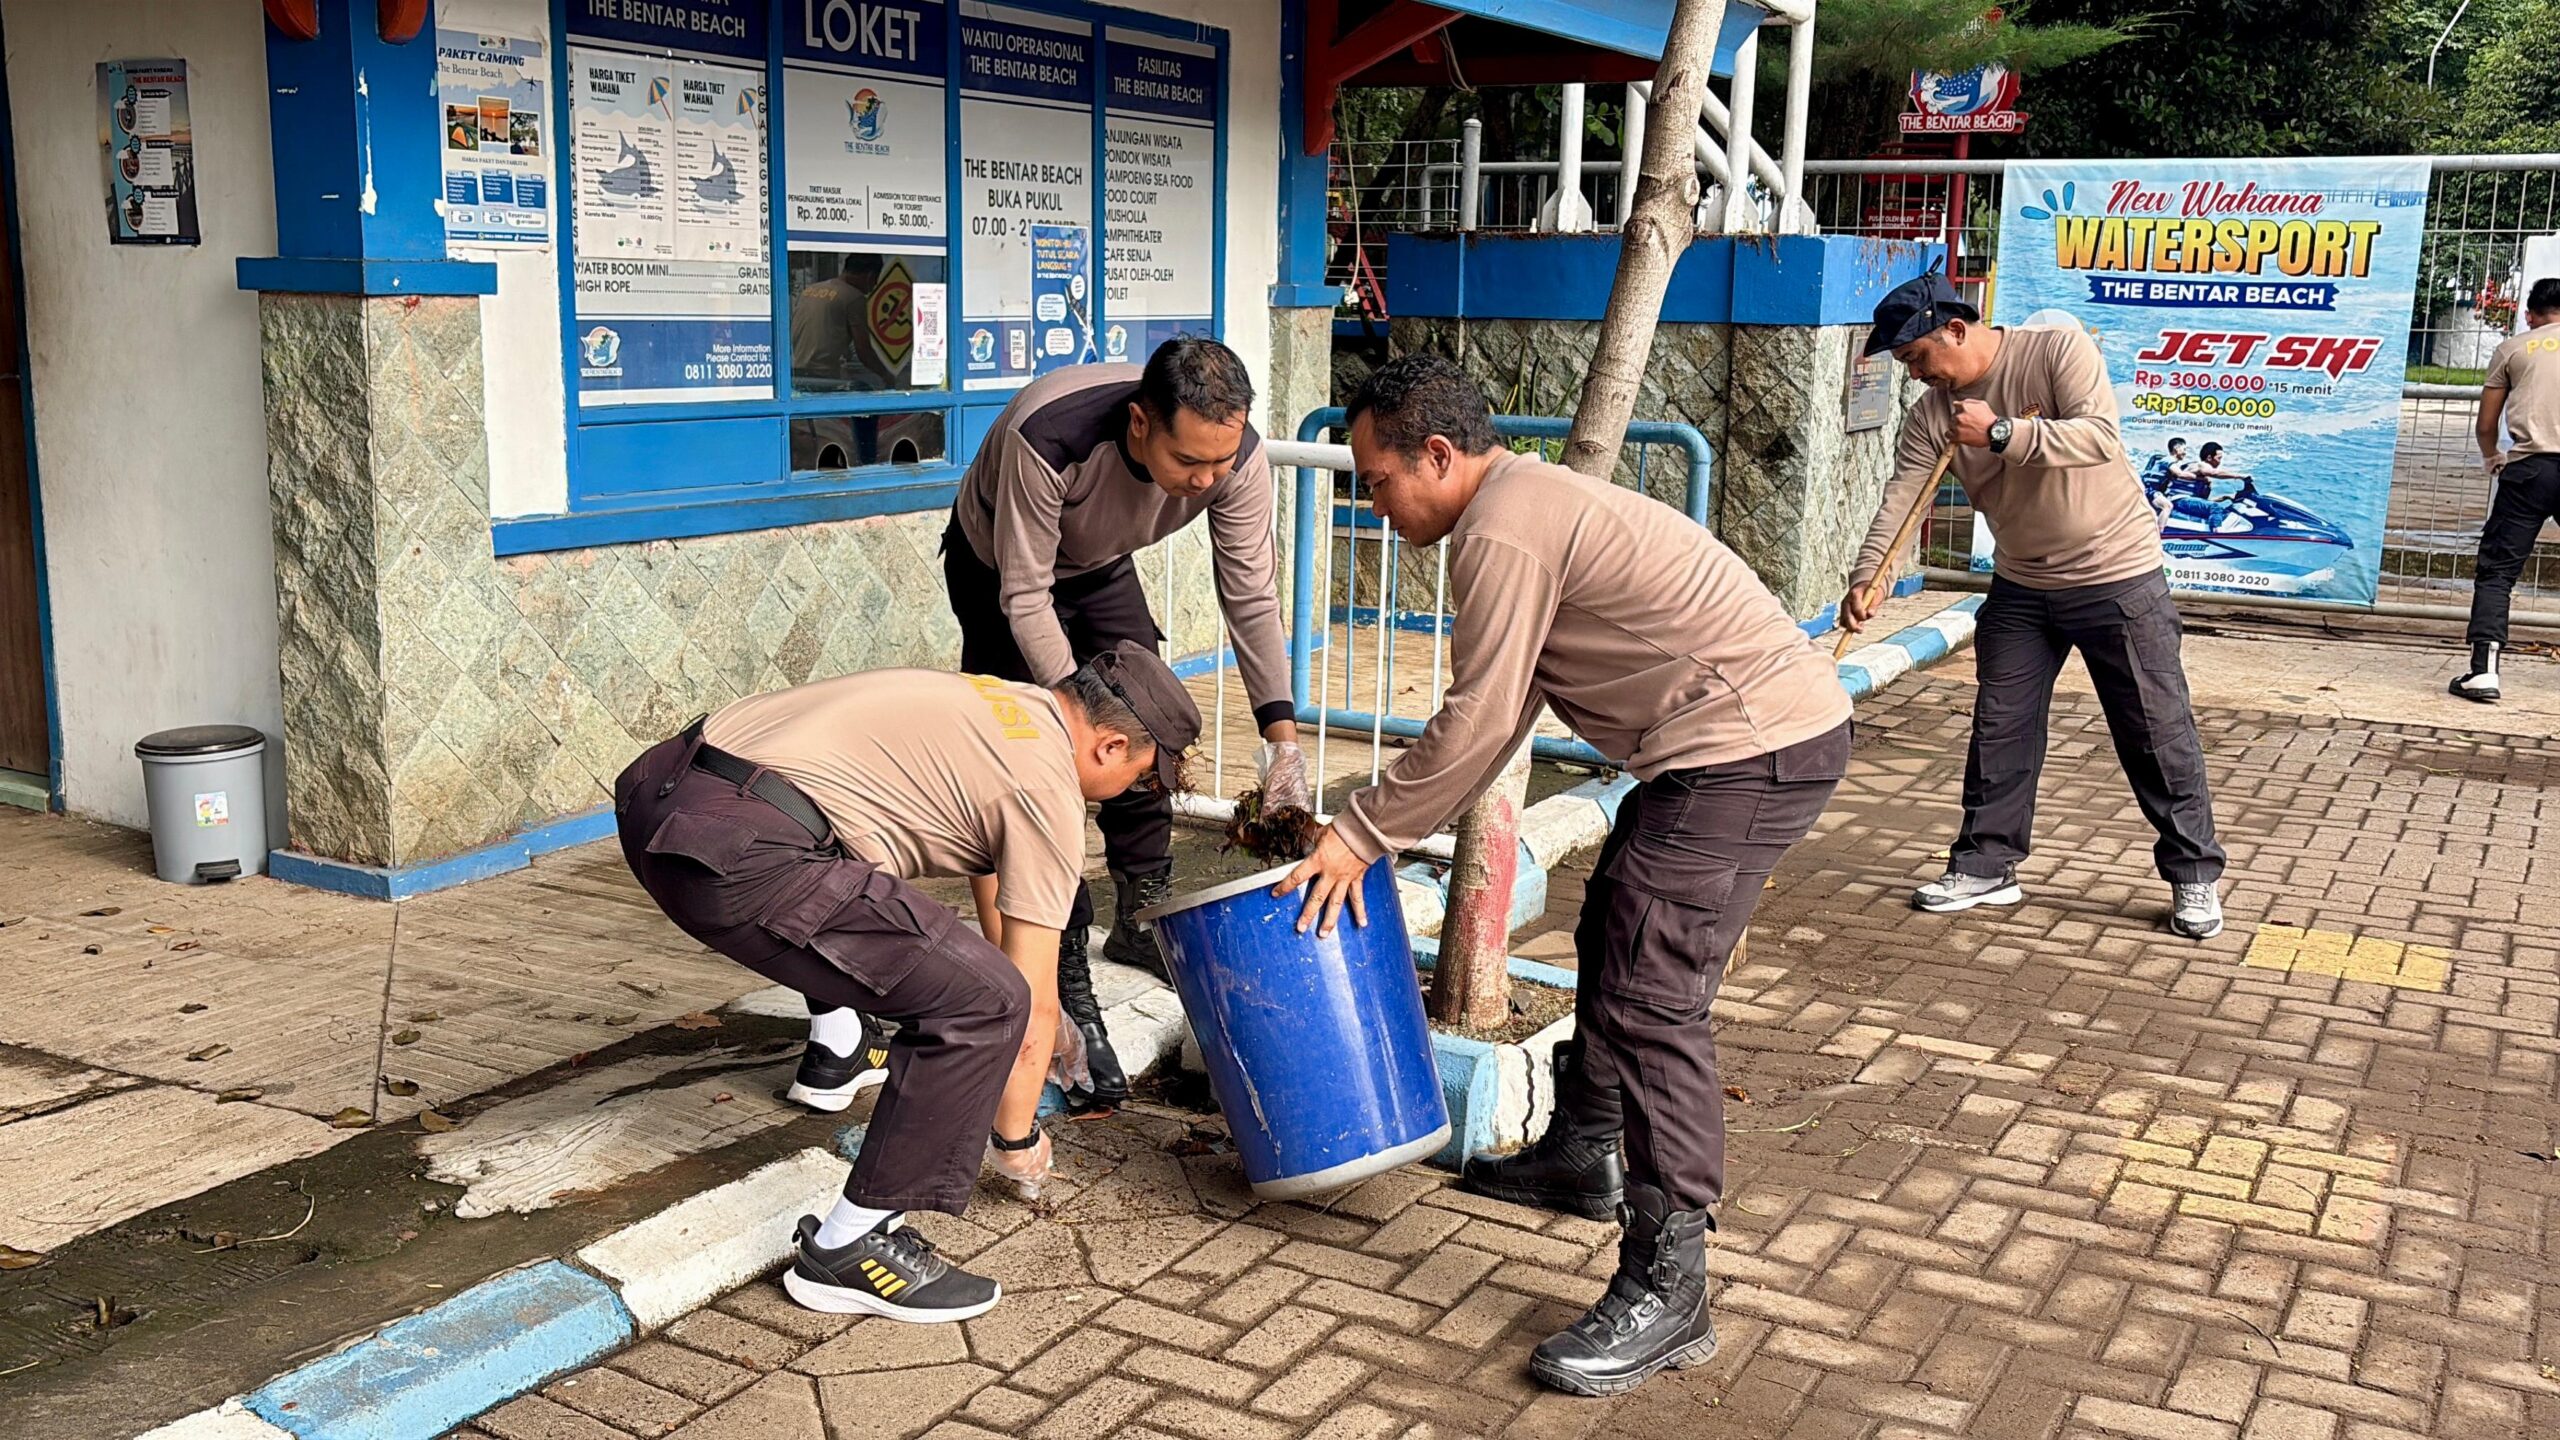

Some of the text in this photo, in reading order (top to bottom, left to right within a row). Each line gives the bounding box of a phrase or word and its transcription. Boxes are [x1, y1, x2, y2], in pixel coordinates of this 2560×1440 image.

[588, 0, 745, 38] THE BENTAR BEACH
[805, 0, 920, 61] LOKET
[962, 27, 1084, 62] WAKTU OPERASIONAL
[438, 47, 525, 66] PAKET CAMPING
[453, 63, 478, 75] Bentar
[481, 67, 502, 78] Beach
[970, 55, 1076, 86] THE BENTAR BEACH
[1137, 56, 1181, 78] FASILITAS
[590, 67, 636, 84] HARGA TIKET
[590, 81, 620, 96] WAHANA
[683, 79, 725, 95] HARGA TIKET
[1114, 76, 1202, 104] THE BENTAR BEACH
[684, 92, 713, 106] WAHANA
[1902, 114, 2013, 130] THE BENTAR BEACH
[844, 141, 853, 149] THE
[875, 144, 890, 152] BEACH
[1153, 134, 1182, 150] WISATA
[1142, 152, 1171, 168] WISATA
[965, 159, 1082, 185] THE BENTAR BEACH
[1154, 174, 1168, 186] SEA
[1171, 175, 1193, 188] FOOD
[788, 194, 824, 204] PENGUNJUNG
[826, 197, 845, 205] WISATA
[873, 192, 900, 200] ADMISSION
[918, 195, 941, 203] ENTRANCE
[988, 189, 1063, 211] BUKA PUKUL
[1130, 191, 1157, 205] COURT
[2106, 179, 2325, 218] New Wahana
[797, 206, 854, 223] Rp. 20.000,-
[883, 213, 934, 229] Rp. 50.000,-
[972, 216, 1007, 236] 07.00
[2055, 215, 2382, 277] WATERSPORT
[1104, 248, 1152, 262] CAFE SENJA
[611, 263, 644, 276] BOOM
[1130, 268, 1174, 281] OLEH-OLEH
[575, 280, 601, 292] HIGH
[2101, 281, 2325, 305] THE BENTAR BEACH
[713, 344, 771, 353] More Information
[2137, 330, 2268, 365] JET
[706, 353, 729, 362] Please
[730, 353, 759, 362] Contact
[685, 364, 772, 380] 0811 3080 2020
[2134, 370, 2163, 389] Rp
[2169, 371, 2265, 392] 300.000
[2292, 384, 2332, 395] menit
[2132, 417, 2182, 426] Dokumentasi
[2233, 423, 2245, 431] (10
[2247, 424, 2273, 432] menit)
[2175, 569, 2270, 586] 0811 3080 2020
